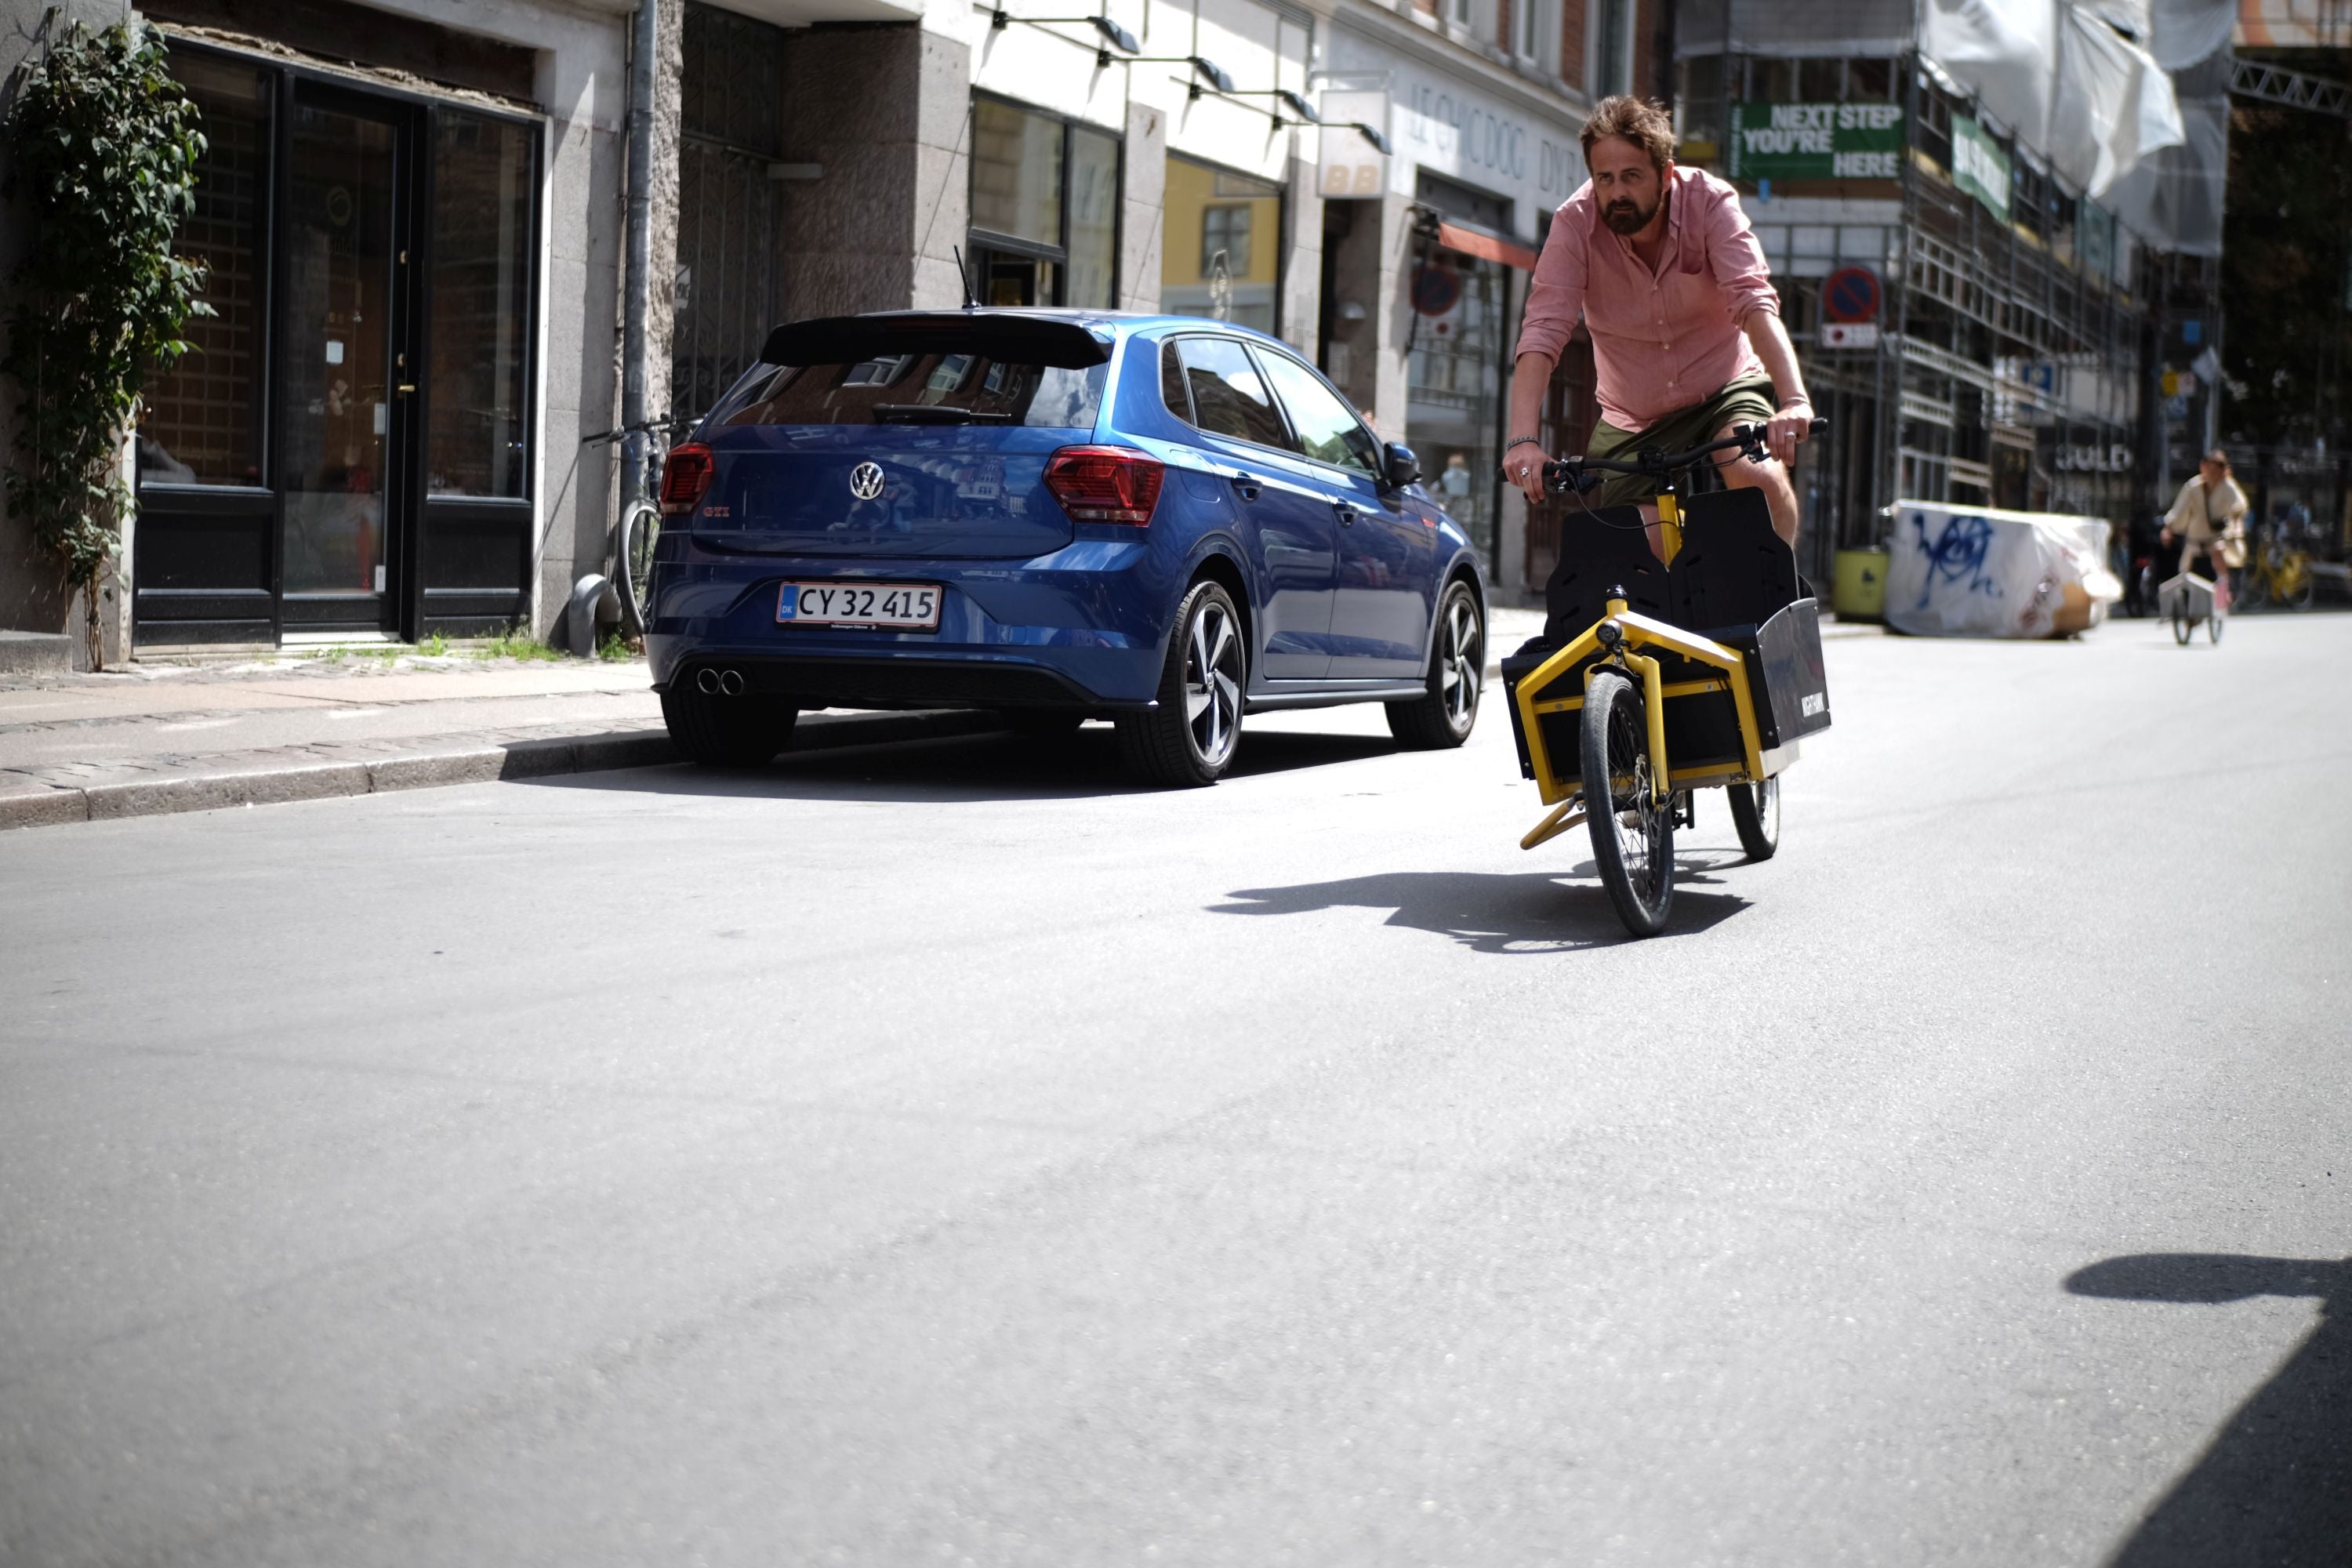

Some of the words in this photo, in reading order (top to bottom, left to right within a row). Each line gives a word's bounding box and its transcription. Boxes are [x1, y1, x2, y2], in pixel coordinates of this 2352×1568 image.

[1770, 106, 1835, 129] NEXT
[1838, 104, 1902, 129] STEP
[1743, 129, 1833, 154] YOU'RE
[1832, 151, 1899, 177] HERE
[702, 506, 730, 517] GTI
[782, 605, 793, 614] DK
[799, 589, 836, 615] CY
[840, 590, 875, 617] 32
[882, 591, 933, 619] 415
